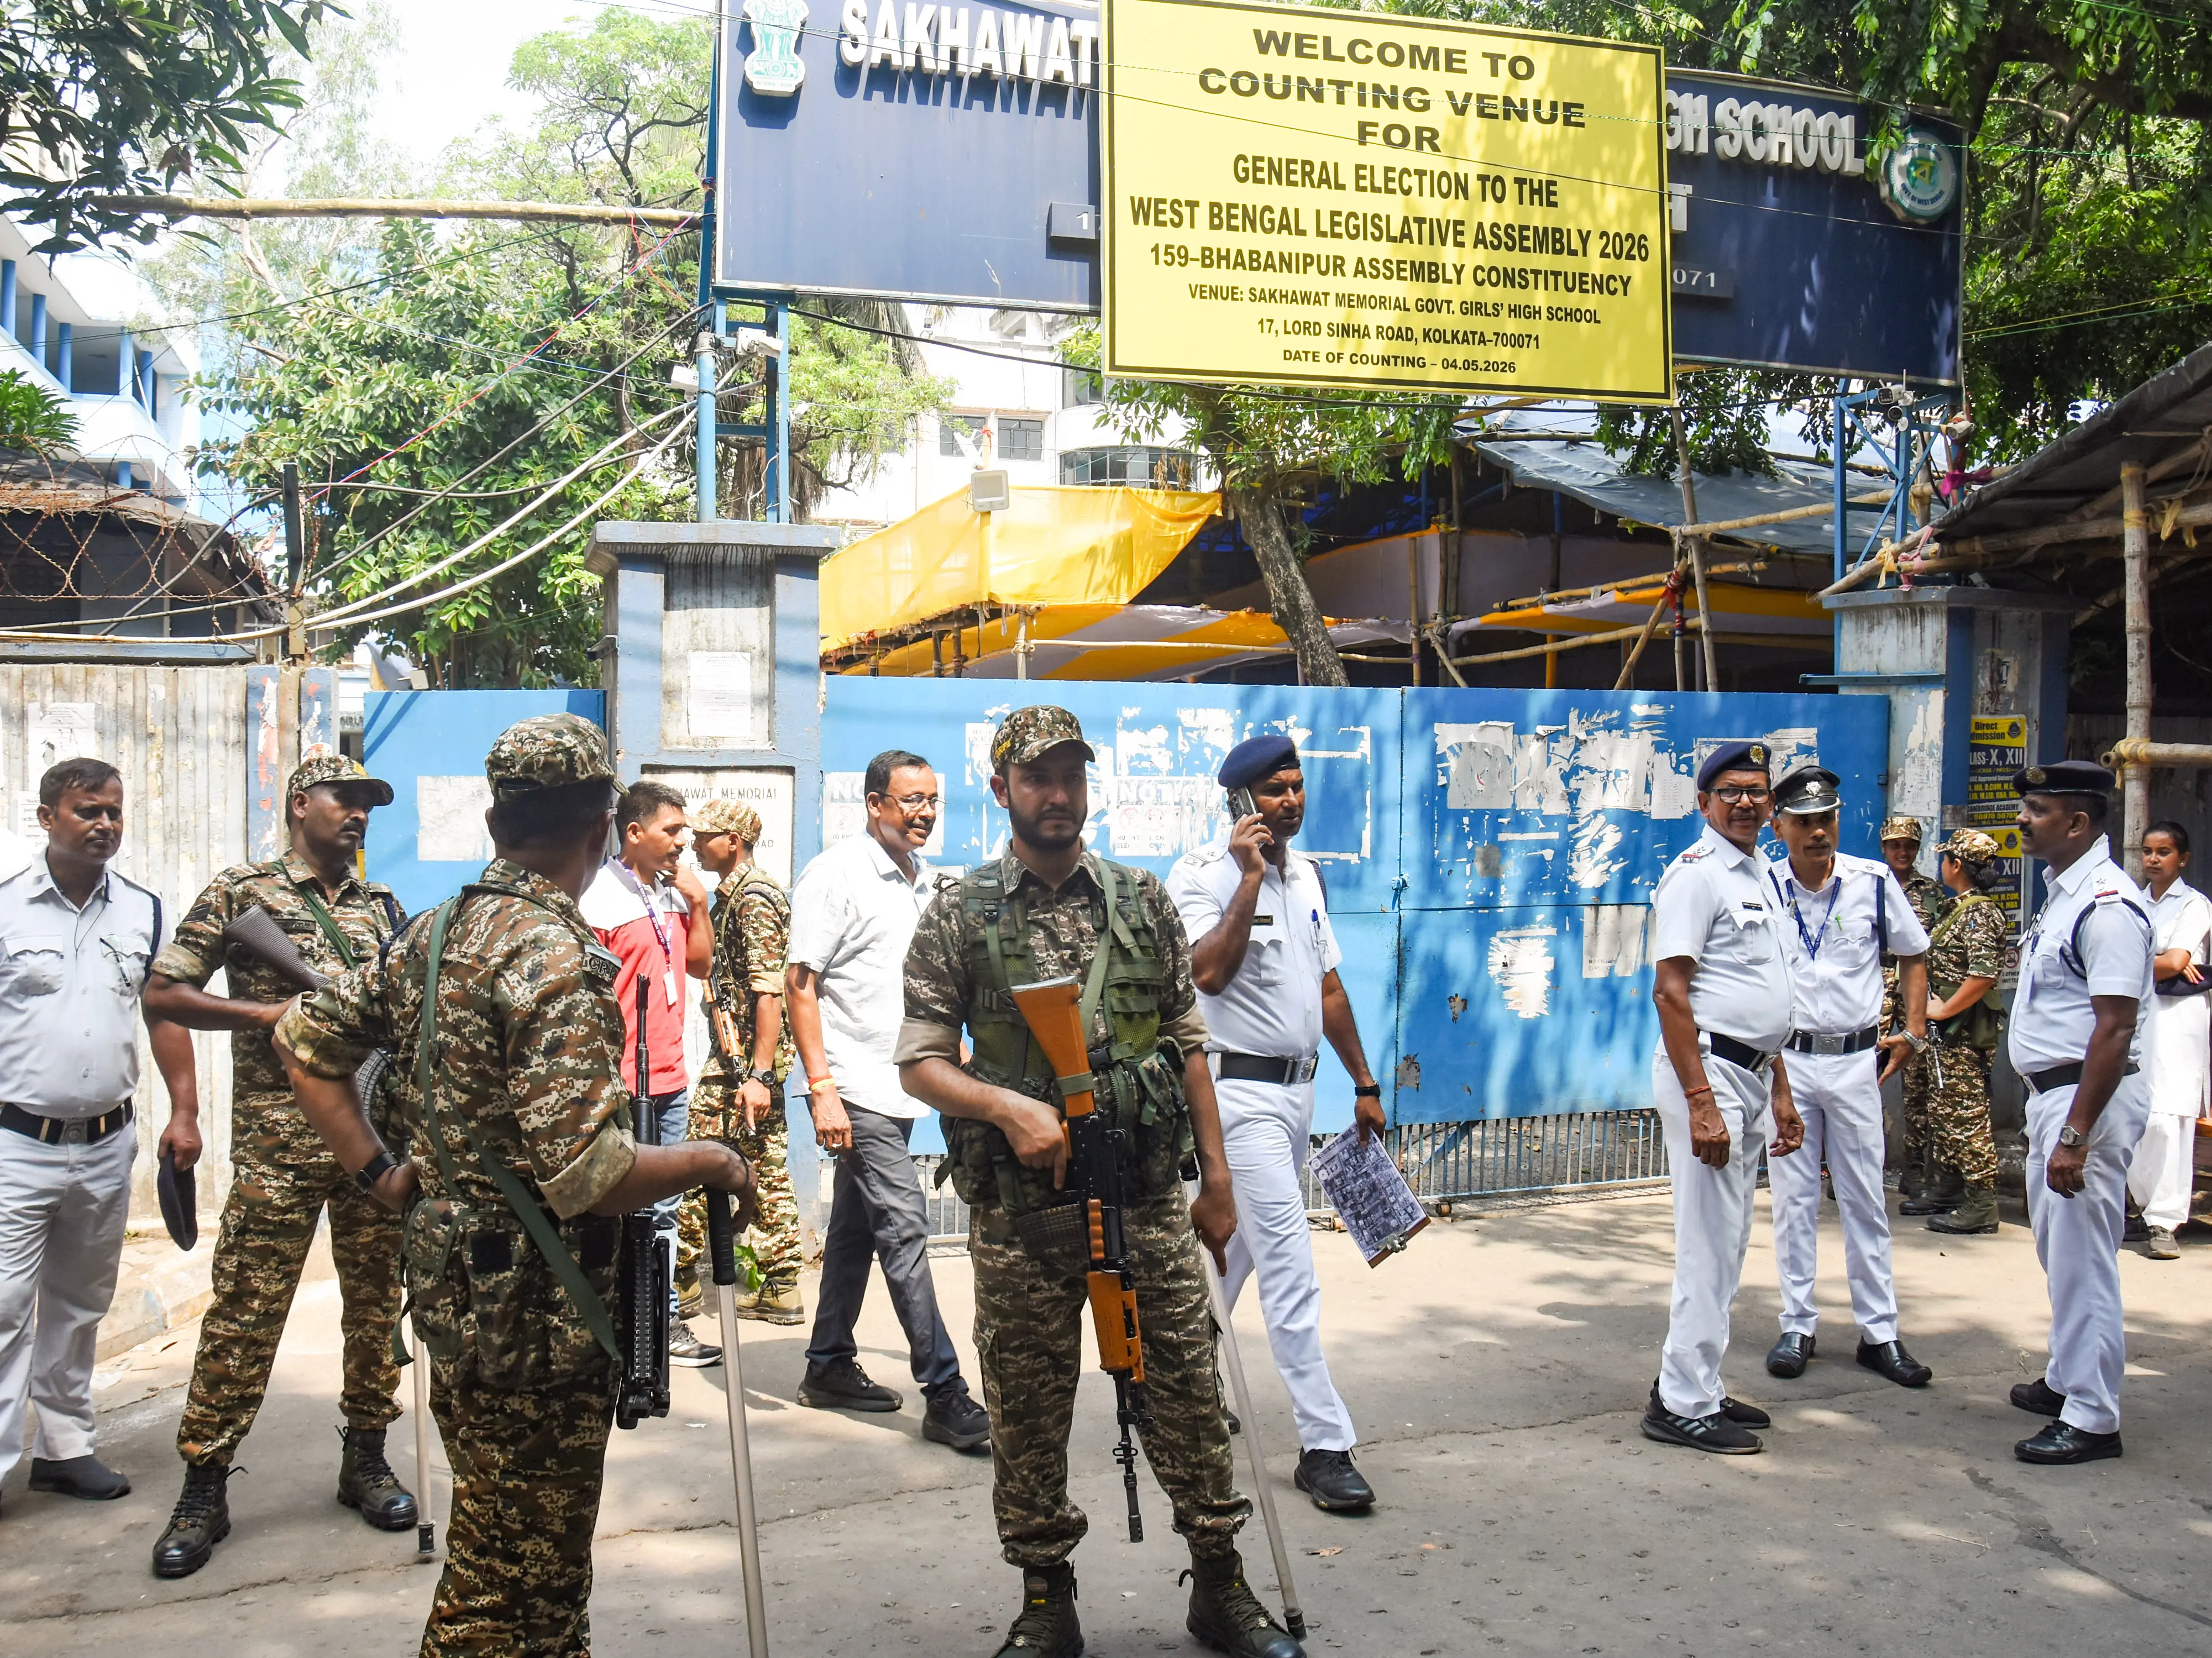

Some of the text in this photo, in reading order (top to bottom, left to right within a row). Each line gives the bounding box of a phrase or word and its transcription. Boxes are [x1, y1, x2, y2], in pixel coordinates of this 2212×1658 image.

[840, 0, 1099, 85] SAKHAWAT
[1254, 30, 1535, 81] WELCOME TO
[1199, 68, 1585, 128] COUNTING VENUE
[1358, 121, 1442, 153] FOR
[1714, 97, 1864, 178] SCHOOL
[1234, 154, 1558, 208] GENERAL ELECTION TO THE
[1130, 197, 1649, 262] WEST BENGAL LEGISLATIVE ASSEMBLY 2026
[1151, 243, 1632, 297] 159-BHABANIPUR ASSEMBLY CONSTITUENCY
[1673, 269, 1715, 287] 071
[1188, 284, 1601, 324] VENUE: SAKHAWAT MEMORIAL GOVT. GIRLS' HIGH SCHOOL
[1258, 319, 1539, 349] 17, LORD SINHA ROAD, KOLKATA-700071
[1283, 349, 1320, 365] DATE
[1325, 352, 1344, 366] OF
[1349, 353, 1426, 371] COUNTING
[1442, 358, 1516, 375] 04.05.2026
[1970, 732, 2005, 741] dmission
[1975, 722, 1998, 730] Direct
[2005, 748, 2023, 764] XII
[2003, 859, 2019, 875] XII
